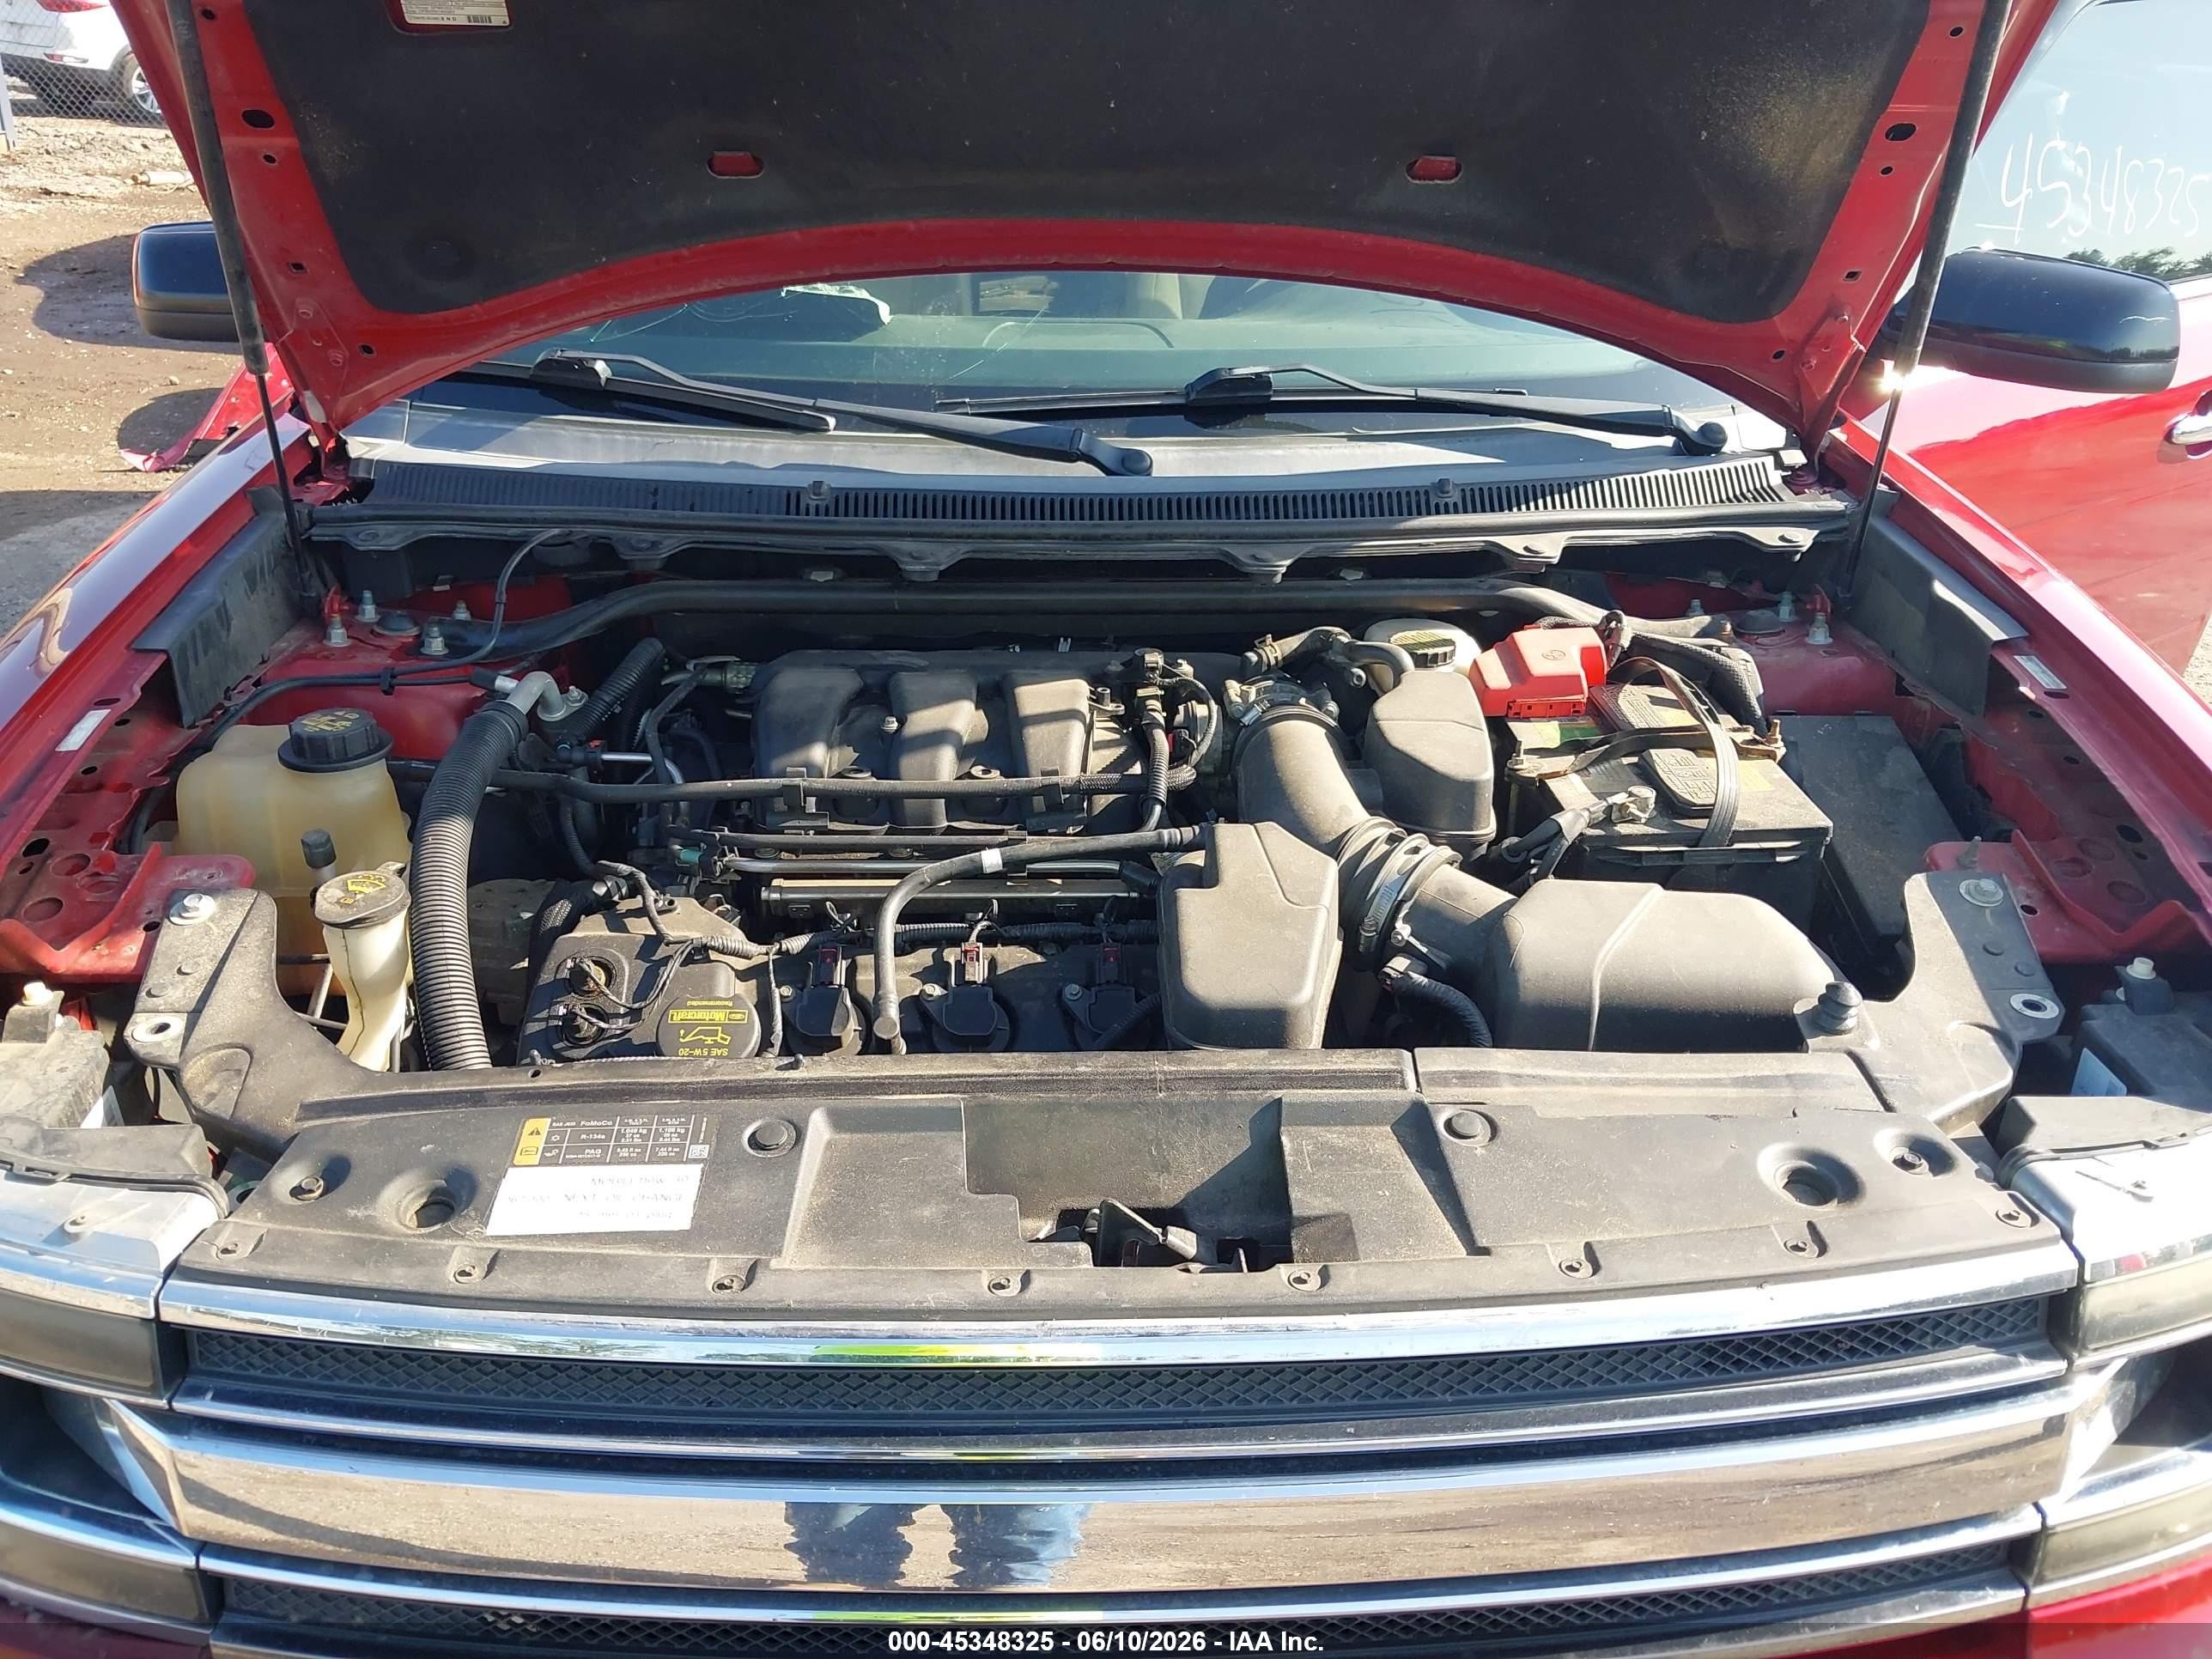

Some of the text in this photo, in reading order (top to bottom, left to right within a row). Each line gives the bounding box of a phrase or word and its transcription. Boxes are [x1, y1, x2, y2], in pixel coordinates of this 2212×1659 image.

[2001, 131, 2212, 245] 45348325
[672, 1011, 726, 1021] Motorcraft
[678, 1048, 729, 1056] SAE 5W-20
